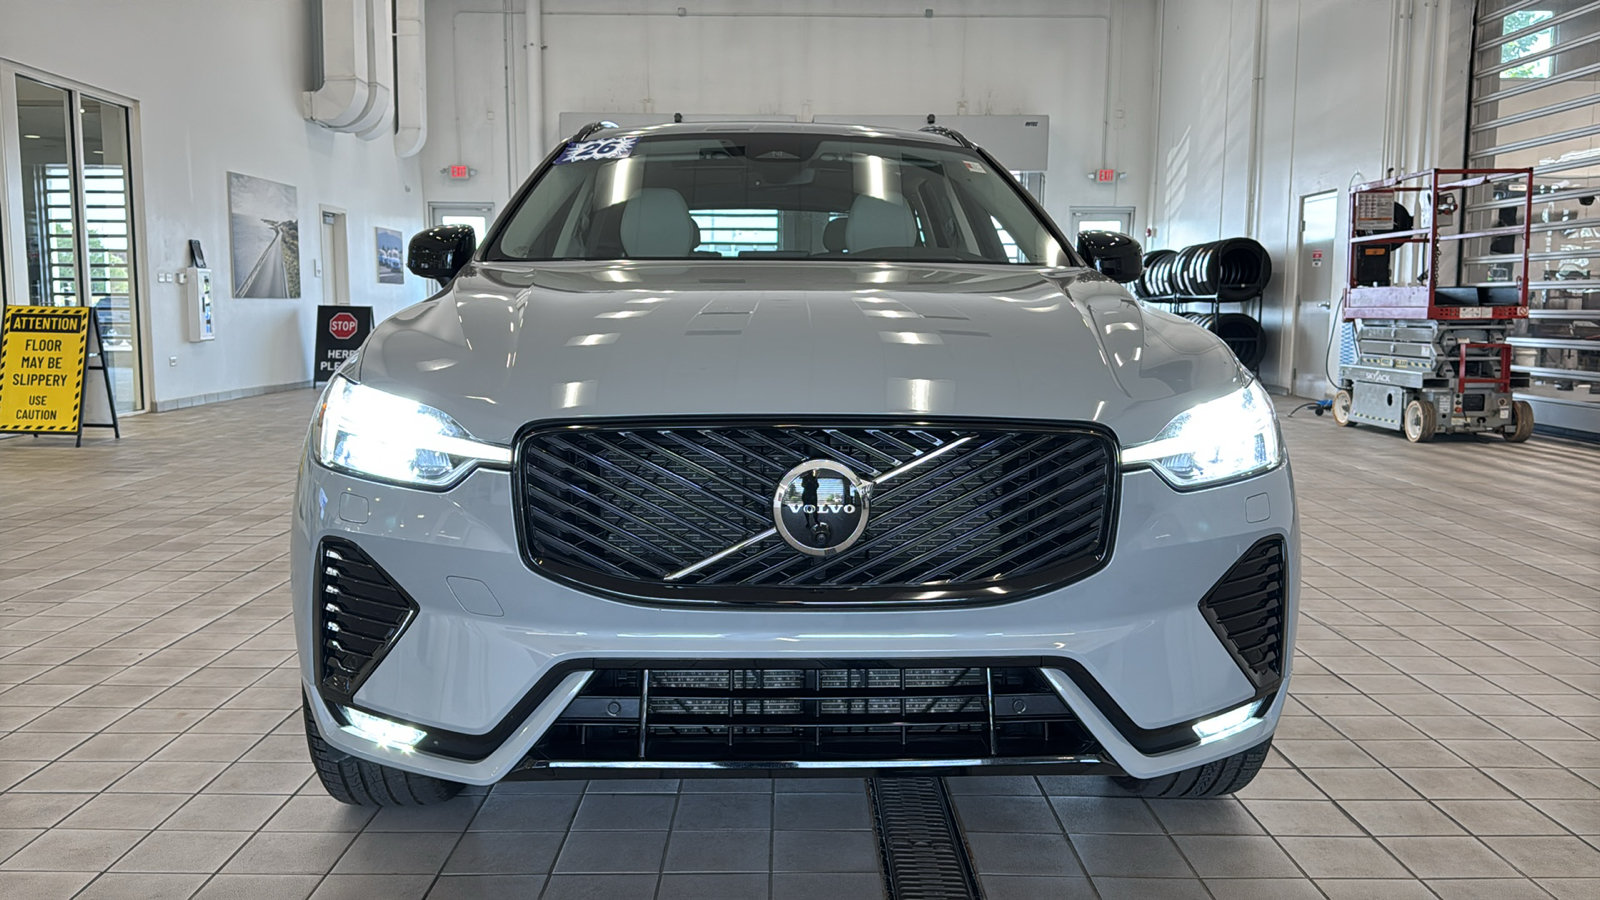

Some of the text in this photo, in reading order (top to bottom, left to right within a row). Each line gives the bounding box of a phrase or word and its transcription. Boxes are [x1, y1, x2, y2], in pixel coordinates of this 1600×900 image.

[575, 141, 621, 157] 26
[451, 165, 467, 177] EXIT
[1099, 169, 1114, 181] EXIT
[13, 317, 77, 331] ATTENTION
[332, 321, 356, 331] STOP
[25, 339, 62, 352] FLOOR
[21, 356, 63, 369] MAY BE
[320, 361, 341, 371] PLE
[12, 373, 68, 386] SLIPPERY
[28, 395, 47, 406] USE
[16, 409, 57, 420] CAUTION
[788, 504, 856, 514] VOLVO
